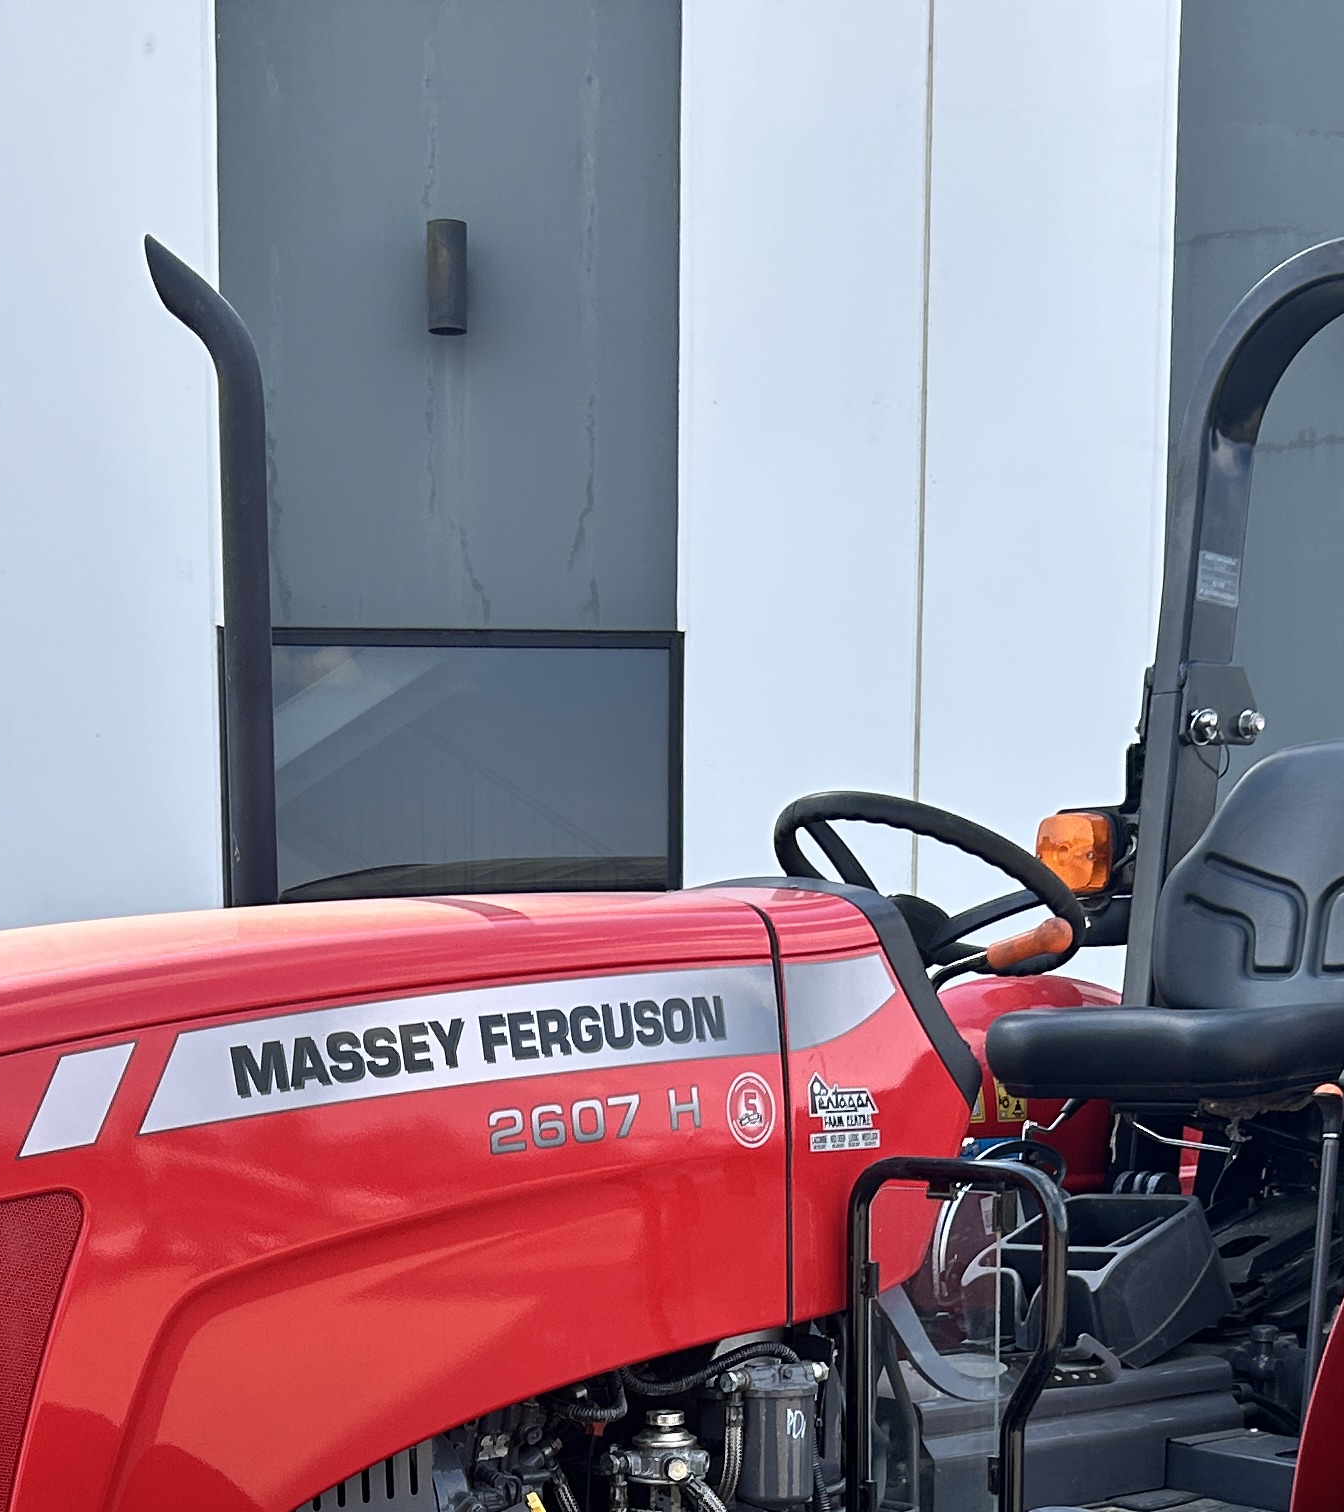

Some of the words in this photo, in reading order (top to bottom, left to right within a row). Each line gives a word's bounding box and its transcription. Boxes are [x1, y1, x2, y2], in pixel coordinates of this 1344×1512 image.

[230, 1018, 464, 1098] MASSEY
[479, 995, 726, 1063] FERGUSON
[489, 1093, 640, 1155] 2607
[668, 1085, 702, 1131] H
